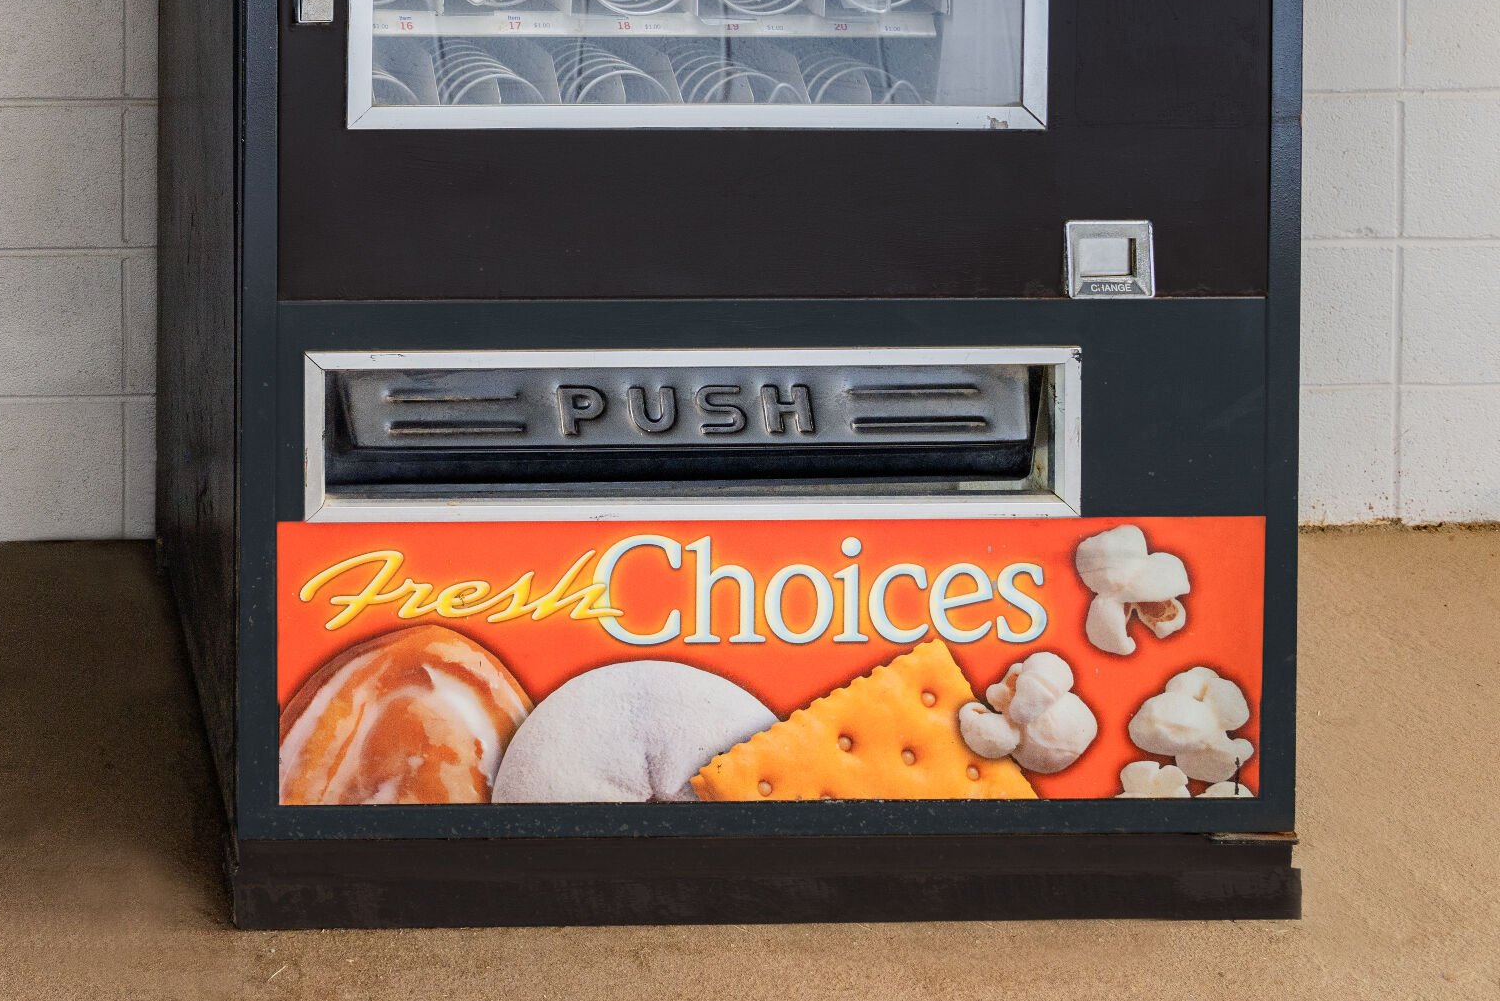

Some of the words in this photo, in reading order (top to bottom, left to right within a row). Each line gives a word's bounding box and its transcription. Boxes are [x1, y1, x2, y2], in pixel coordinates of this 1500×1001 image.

[400, 22, 414, 30] 16
[509, 22, 522, 30] 17
[618, 22, 630, 30] 18
[557, 384, 816, 437] PUSH
[299, 549, 624, 631] Fresh
[593, 534, 1048, 646] Choices
